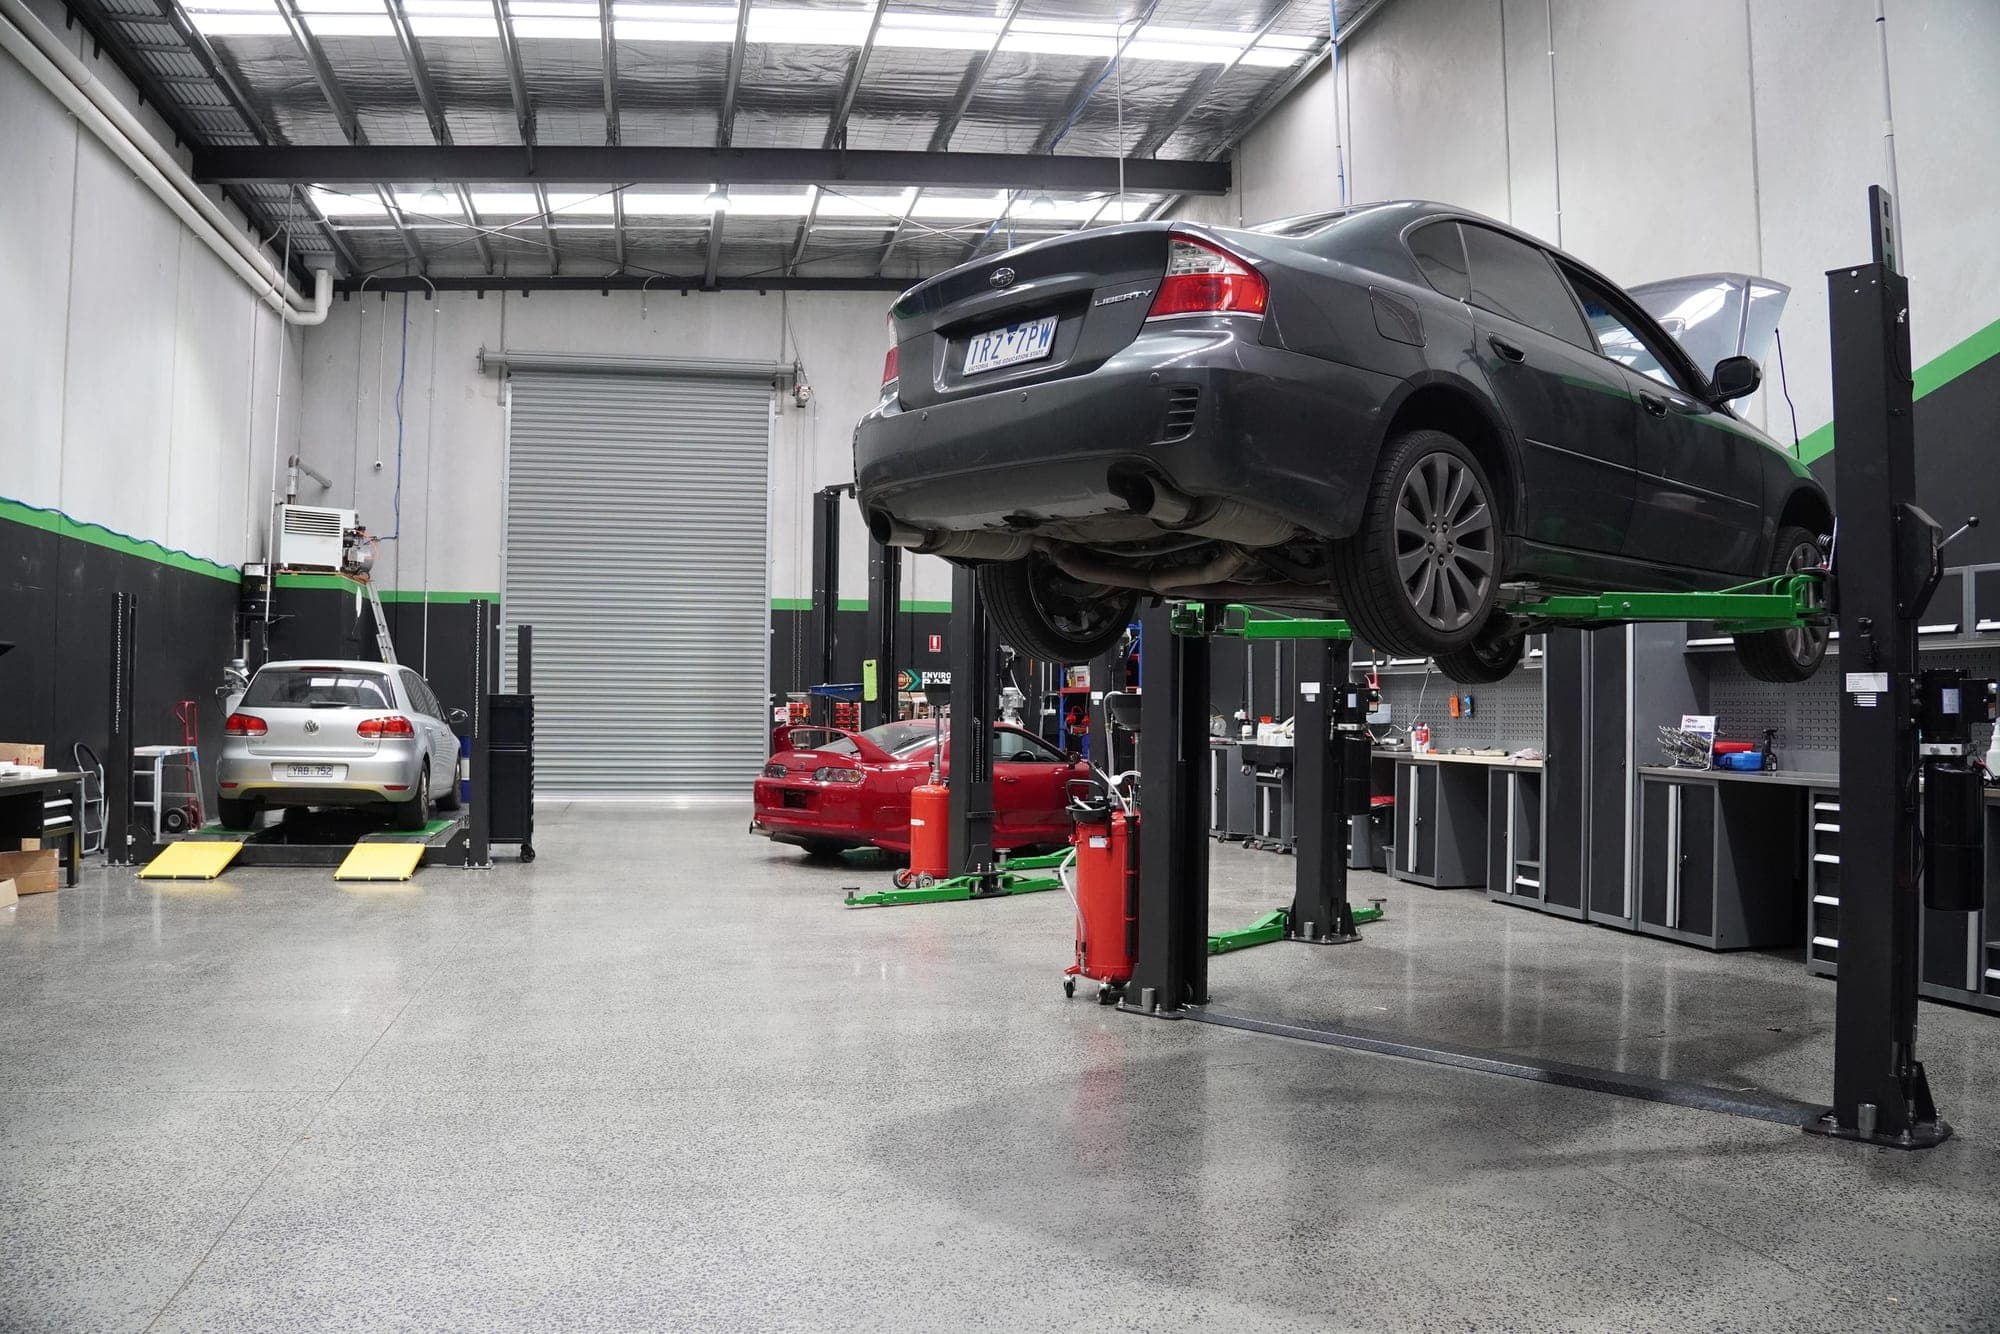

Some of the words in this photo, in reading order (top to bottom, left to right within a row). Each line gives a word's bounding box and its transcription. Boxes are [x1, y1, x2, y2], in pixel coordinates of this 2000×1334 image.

[1094, 289, 1153, 307] LIBERTY
[971, 333, 1004, 365] 1RZ
[1016, 321, 1053, 354] 7PW
[921, 671, 952, 679] ENVIRO
